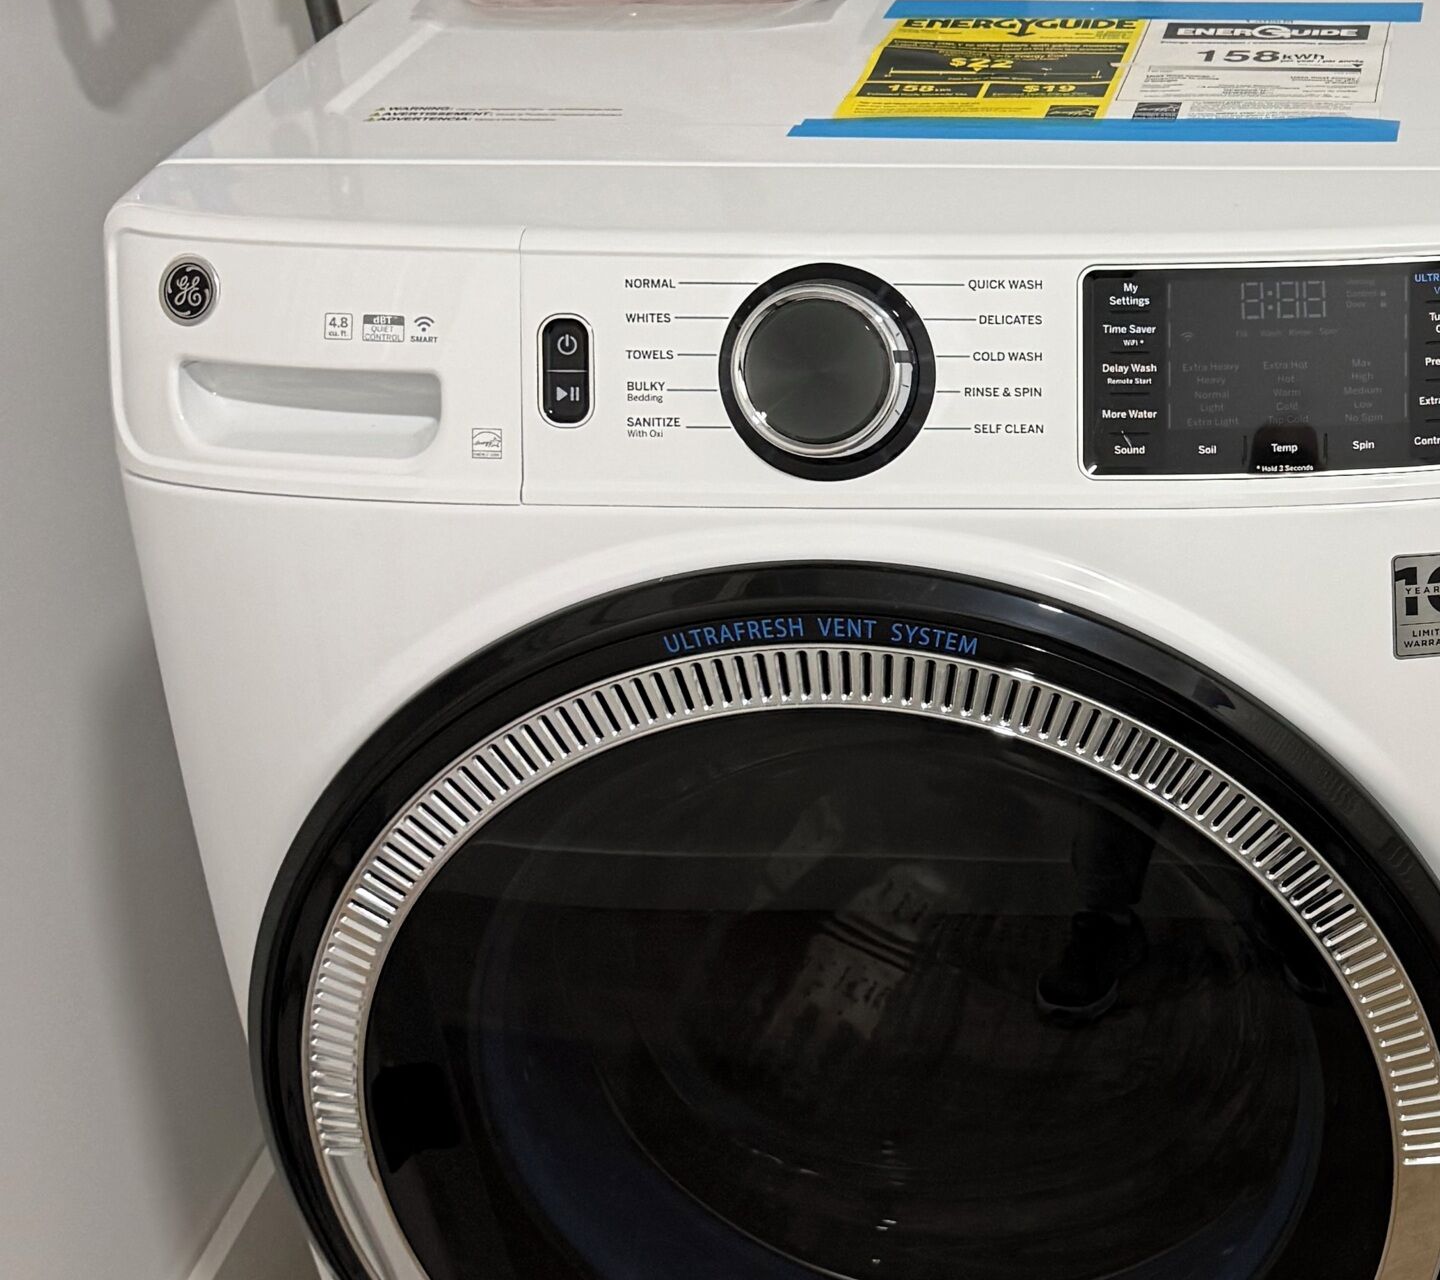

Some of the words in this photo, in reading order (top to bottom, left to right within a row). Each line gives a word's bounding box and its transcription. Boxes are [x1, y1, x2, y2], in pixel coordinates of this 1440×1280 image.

[902, 19, 1137, 33] ENERGYGUIDE
[1197, 50, 1280, 63] 158
[1281, 52, 1325, 61] kWh
[950, 57, 1014, 69] $22
[888, 84, 936, 93] 158
[1022, 84, 1077, 94] $19
[625, 279, 676, 289] NORMAL
[968, 280, 1006, 291] QUICK
[1009, 280, 1042, 289] WASH
[1123, 283, 1138, 294] My
[1109, 296, 1150, 307] Settings
[329, 317, 348, 328] 4.8
[373, 316, 392, 324] dBT
[626, 313, 671, 323] WHITES
[979, 315, 1042, 325] DELICATES
[1103, 325, 1127, 333] Time
[1129, 325, 1156, 333] Saver
[626, 350, 674, 360] TOWELS
[973, 352, 1003, 362] COLD
[1009, 352, 1042, 361] WASH
[1102, 364, 1129, 374] Delay
[1131, 364, 1157, 373] Wash
[627, 382, 665, 392] BULKY
[964, 387, 1000, 397] RINSE
[1003, 387, 1012, 397] &
[1014, 387, 1042, 397] SPIN
[1344, 386, 1382, 395] Medium
[1194, 390, 1230, 399] Normal
[1273, 389, 1301, 397] Warm
[627, 393, 663, 404] Bedding
[1102, 410, 1126, 419] More
[1128, 409, 1157, 419] Water
[627, 418, 681, 427] SANITIZE
[627, 430, 645, 438] With
[648, 430, 663, 438] Oxi
[974, 424, 1001, 434] SELF
[1004, 424, 1044, 434] CLEAN
[1115, 445, 1145, 455] Sound
[1198, 445, 1217, 454] Soil
[1271, 443, 1298, 453] Temp
[1352, 441, 1375, 450] Spin
[1405, 586, 1440, 594] YEAR
[663, 618, 804, 653] ULTRAFRESH
[817, 618, 877, 639] VENT
[891, 623, 978, 655] SYSTEM
